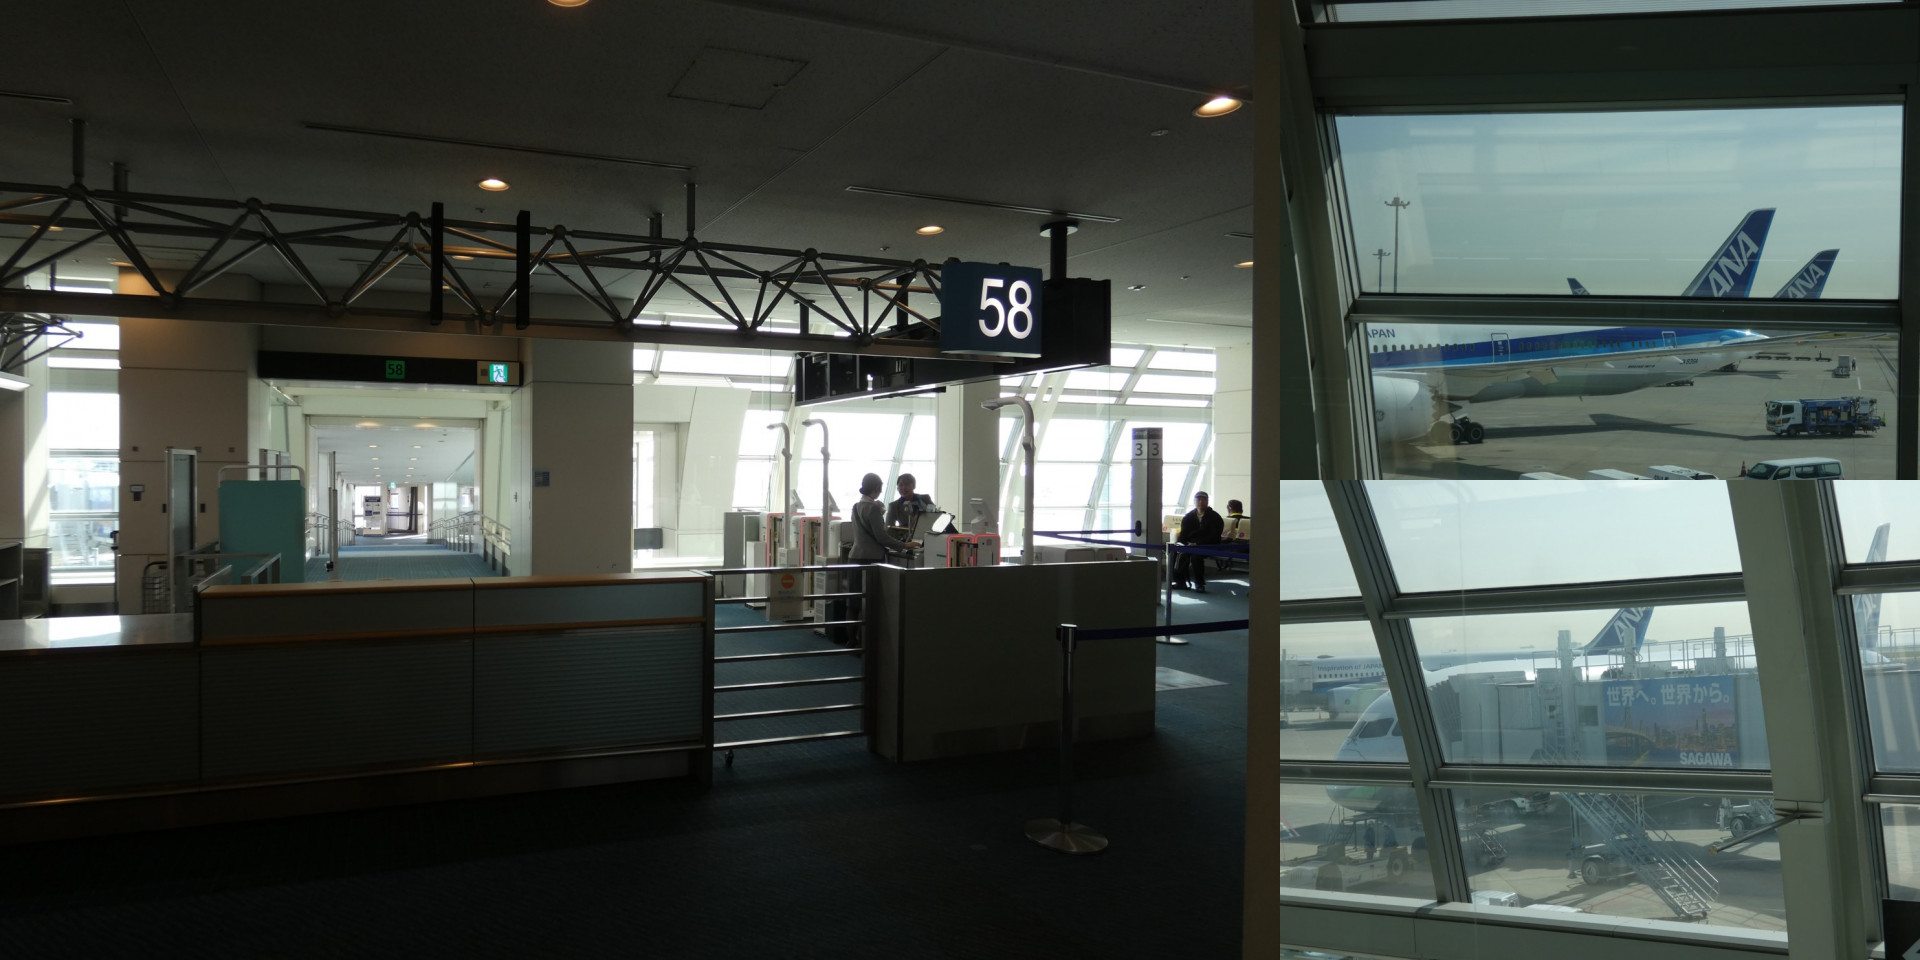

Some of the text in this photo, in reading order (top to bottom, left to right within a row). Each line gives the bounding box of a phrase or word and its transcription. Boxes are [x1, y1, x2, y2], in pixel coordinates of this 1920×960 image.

[1708, 230, 1760, 297] ANA
[1787, 263, 1826, 298] ANA
[979, 278, 1033, 340] 58
[388, 363, 404, 376] 58
[1135, 442, 1143, 457] 3
[1151, 442, 1160, 457] 3
[1613, 606, 1651, 643] AN
[1680, 752, 1733, 766] SAGAWA
